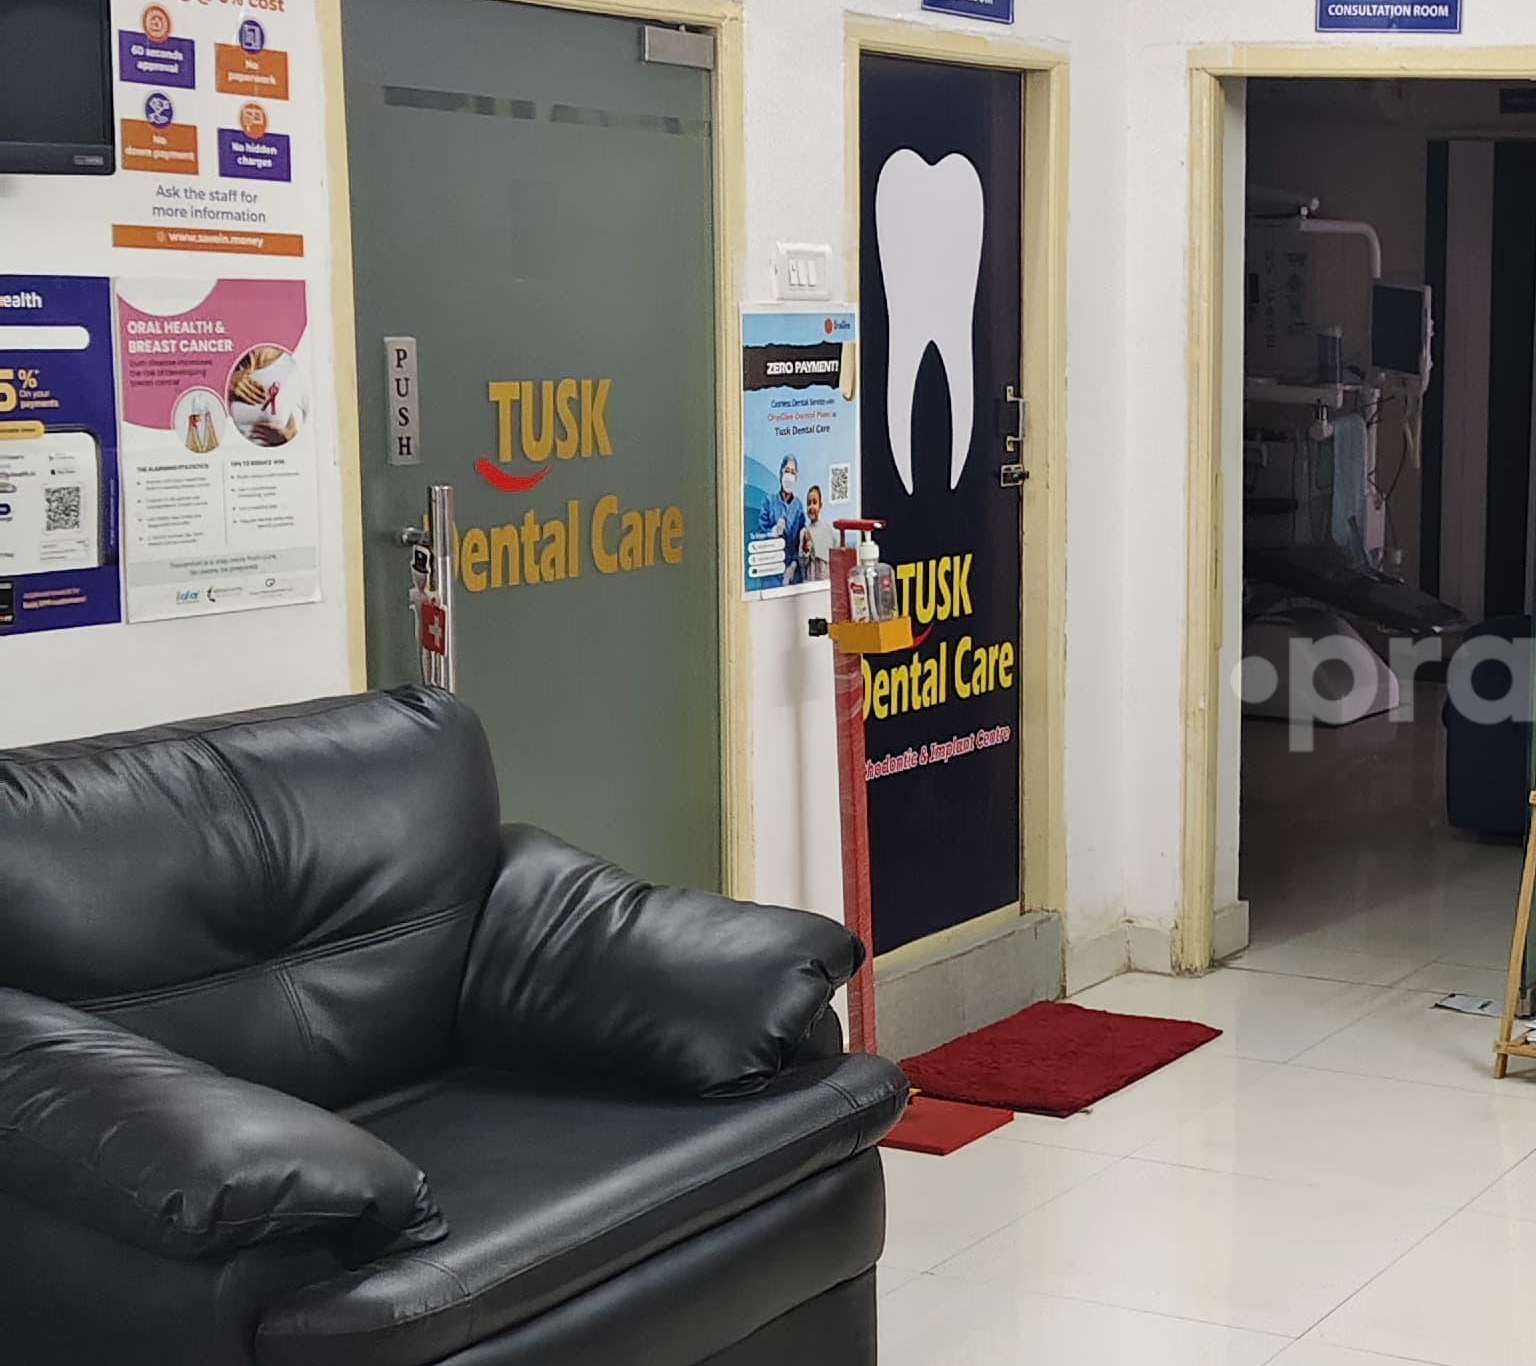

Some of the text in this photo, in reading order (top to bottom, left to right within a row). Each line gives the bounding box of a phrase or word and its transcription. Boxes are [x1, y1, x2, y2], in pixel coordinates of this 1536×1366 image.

[1328, 4, 1449, 18] CONSULTATION ROOM
[231, 141, 277, 155] No hidden
[237, 155, 272, 169] charges
[156, 185, 257, 203] Ask the staff for
[152, 205, 266, 223] more information
[0, 292, 43, 309] ealth
[127, 320, 224, 335] ORAL HEALTH &
[128, 339, 233, 354] BREAST CANCER
[766, 361, 793, 375] ZERO
[394, 348, 413, 456] PUSH
[488, 378, 614, 463] TUSK
[775, 424, 830, 436] Tusk Dental Care
[591, 494, 685, 573] Care
[897, 553, 973, 624] TUSK
[954, 635, 1014, 699] Care
[865, 725, 1010, 781] hodontic & Implant Centre
